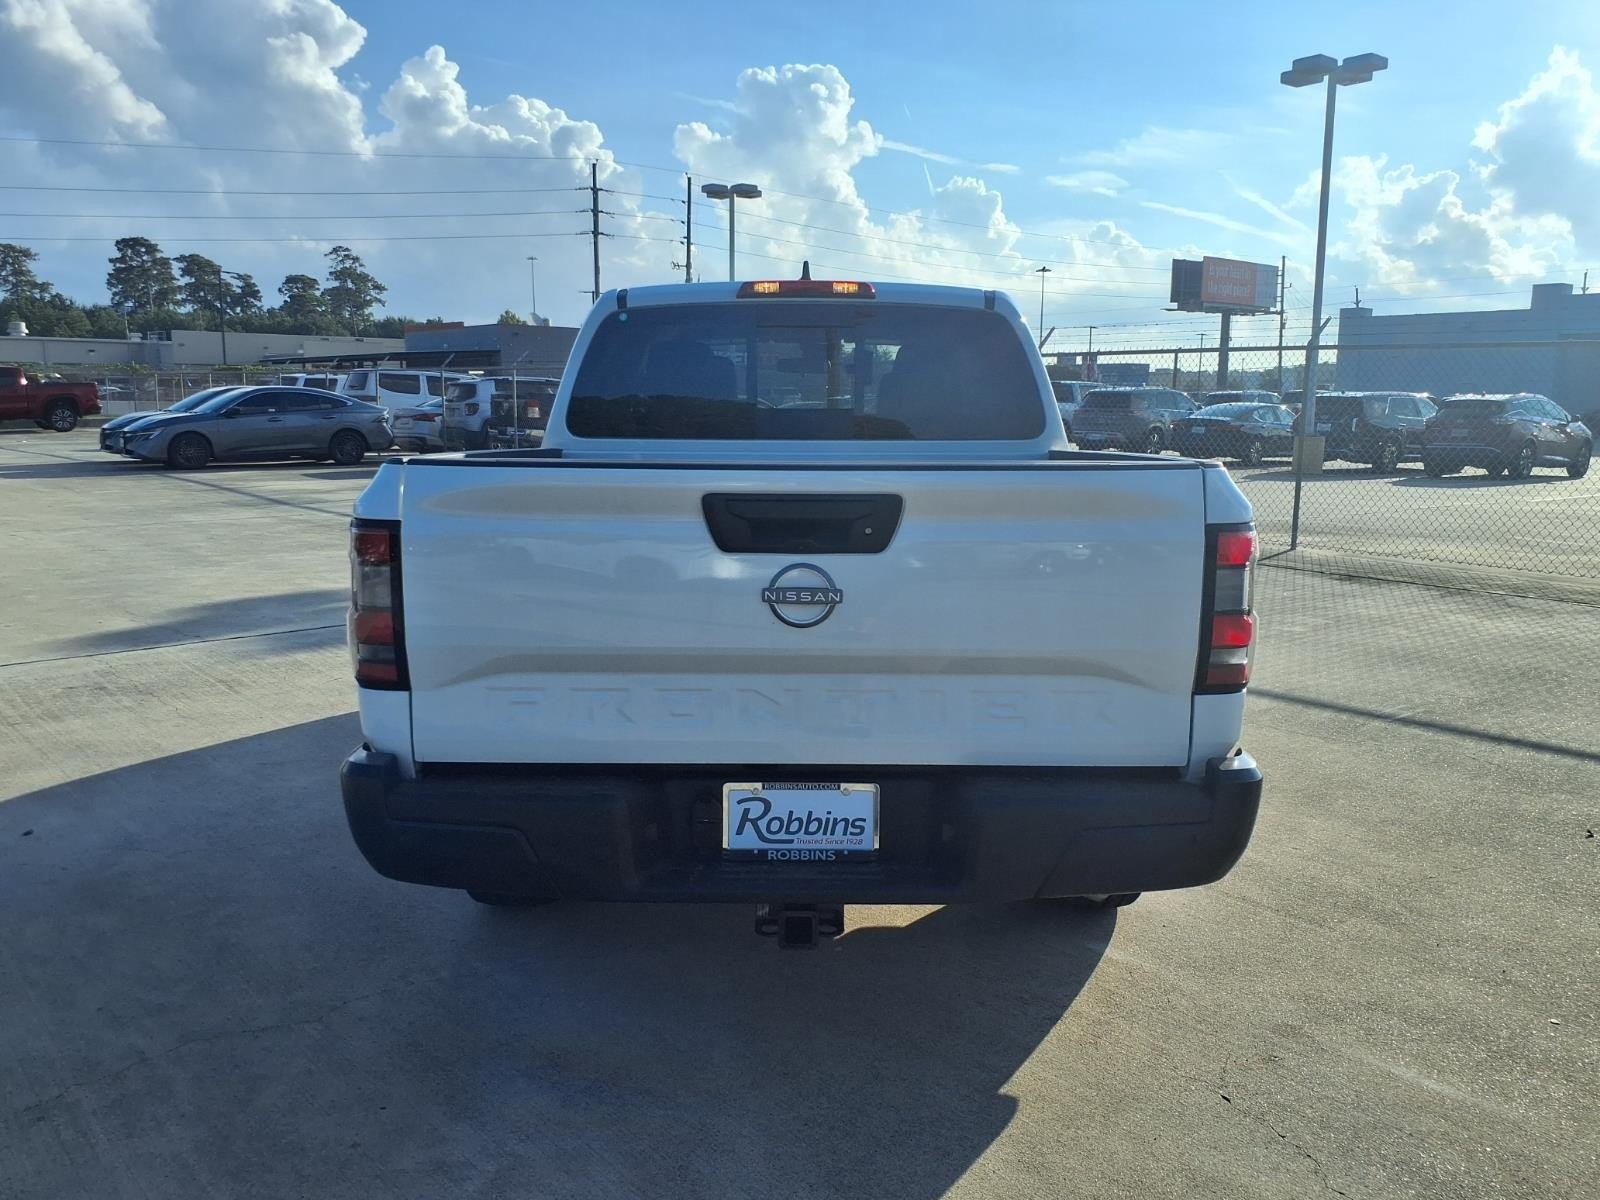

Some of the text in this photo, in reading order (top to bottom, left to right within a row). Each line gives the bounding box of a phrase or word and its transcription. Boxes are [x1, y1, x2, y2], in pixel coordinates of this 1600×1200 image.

[764, 591, 840, 602] NISSAN
[484, 686, 1122, 731] FRONTIER
[735, 796, 867, 845] Robbins
[796, 837, 864, 846] Trusted Since 1928
[768, 849, 836, 861] ROBBINS
